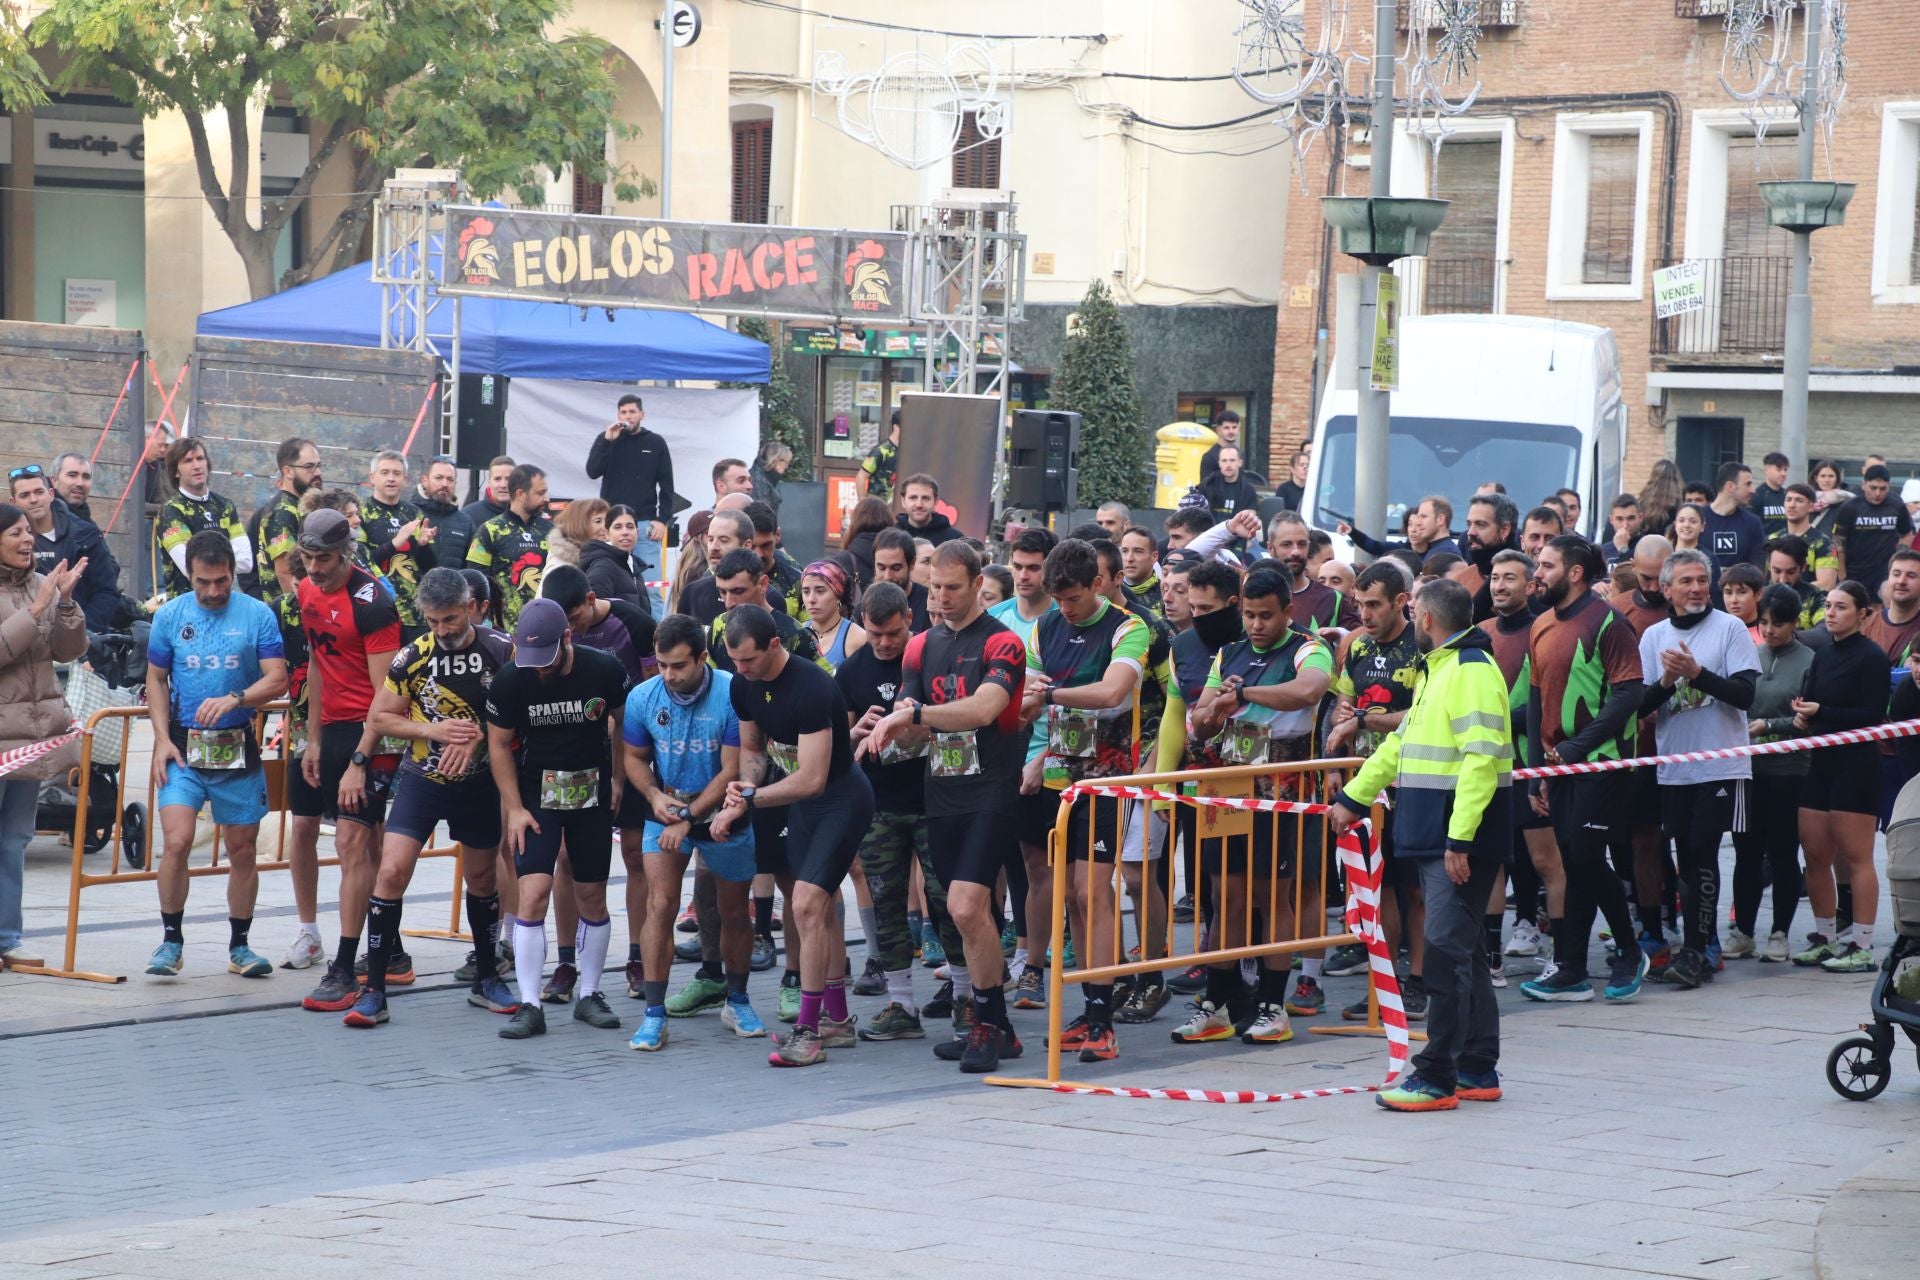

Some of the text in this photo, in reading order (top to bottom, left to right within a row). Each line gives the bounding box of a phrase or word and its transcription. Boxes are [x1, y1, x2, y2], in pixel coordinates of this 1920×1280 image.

[464, 267, 489, 276] EOLOS
[513, 226, 817, 301] EOLOS RACE
[467, 276, 490, 285] RACE
[851, 293, 877, 301] EOLOS
[1661, 283, 1695, 301] VENDE
[853, 302, 879, 311] RACE
[1658, 303, 1672, 316] 601
[1855, 516, 1898, 526] ATHLETE
[997, 642, 1023, 662] IN
[186, 655, 240, 670] 835
[428, 653, 483, 677] 1159
[528, 700, 583, 717] SPARTAN
[530, 711, 584, 727] TURIASO TEAM
[200, 744, 233, 761] 126
[657, 739, 718, 755] 3355
[943, 749, 962, 767] 88
[555, 784, 589, 802] 125
